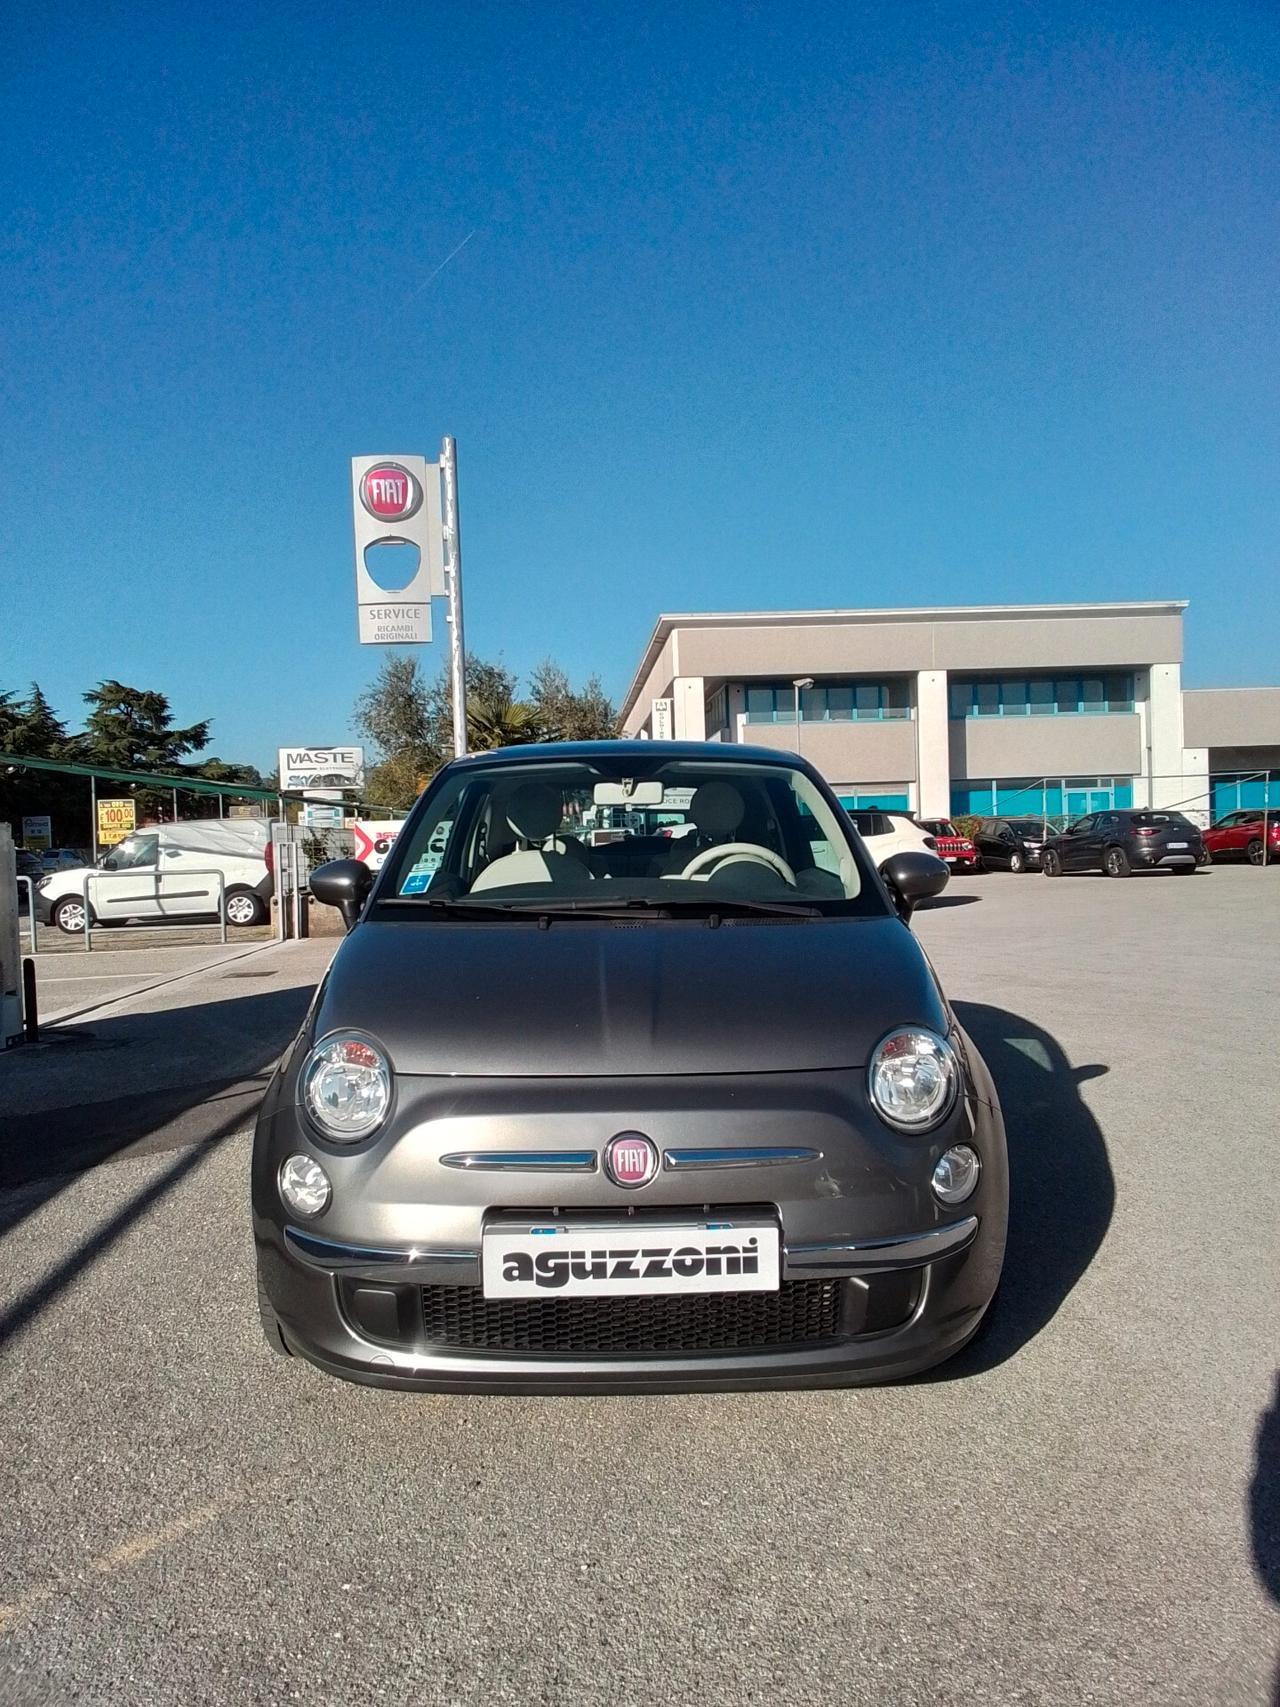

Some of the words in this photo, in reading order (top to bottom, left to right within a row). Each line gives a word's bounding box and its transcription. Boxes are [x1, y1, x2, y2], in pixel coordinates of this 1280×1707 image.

[371, 478, 405, 505] FIAT
[369, 608, 421, 620] SERVICE
[374, 632, 418, 641] ORIGINALI
[377, 625, 414, 633] RICAMBI
[617, 1148, 646, 1173] FIAT
[502, 1236, 759, 1289] aguzzoni
